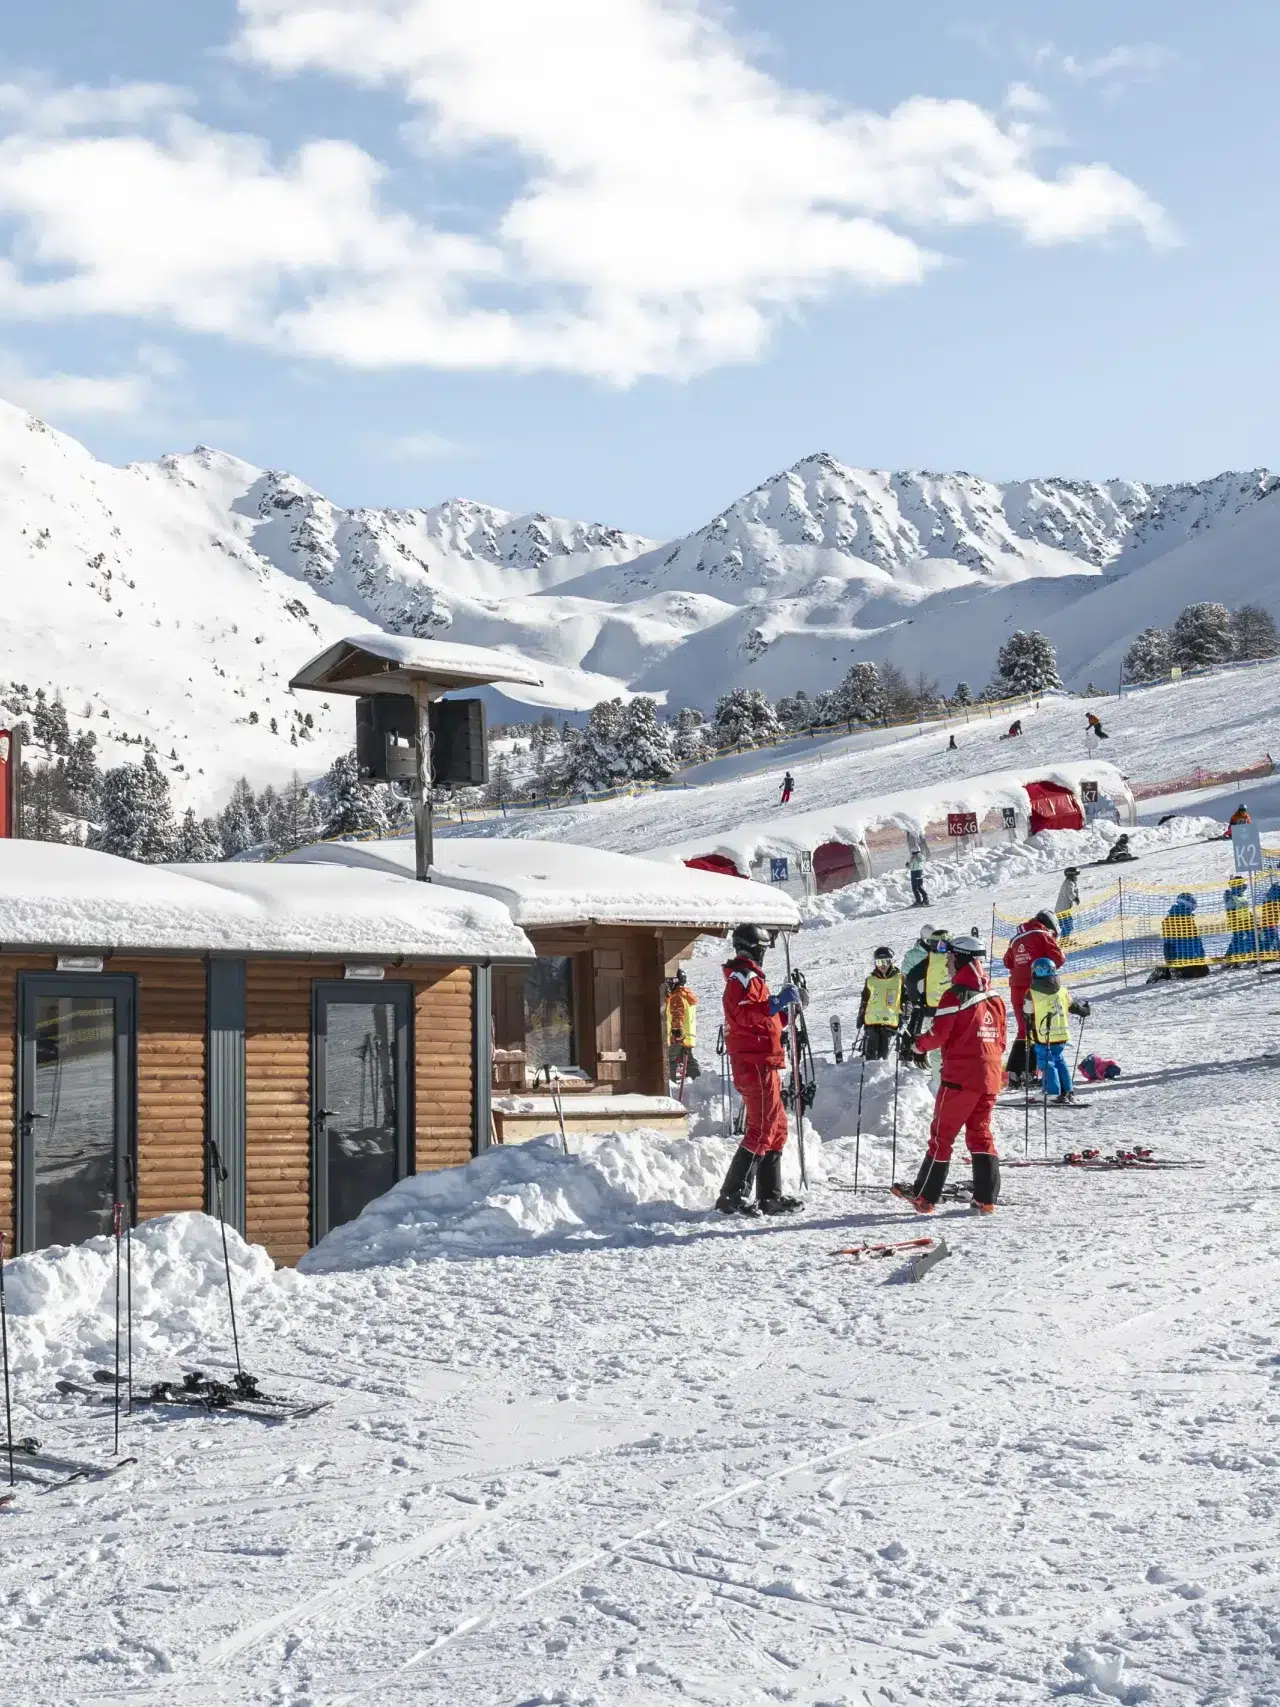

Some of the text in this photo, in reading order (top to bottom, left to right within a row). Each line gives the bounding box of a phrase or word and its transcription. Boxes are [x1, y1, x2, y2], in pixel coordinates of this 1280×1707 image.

[1083, 790, 1096, 802] K7
[963, 821, 977, 833] K6
[1003, 816, 1015, 828] K9
[950, 823, 963, 835] K5
[1235, 844, 1258, 867] K2
[772, 868, 787, 879] K4
